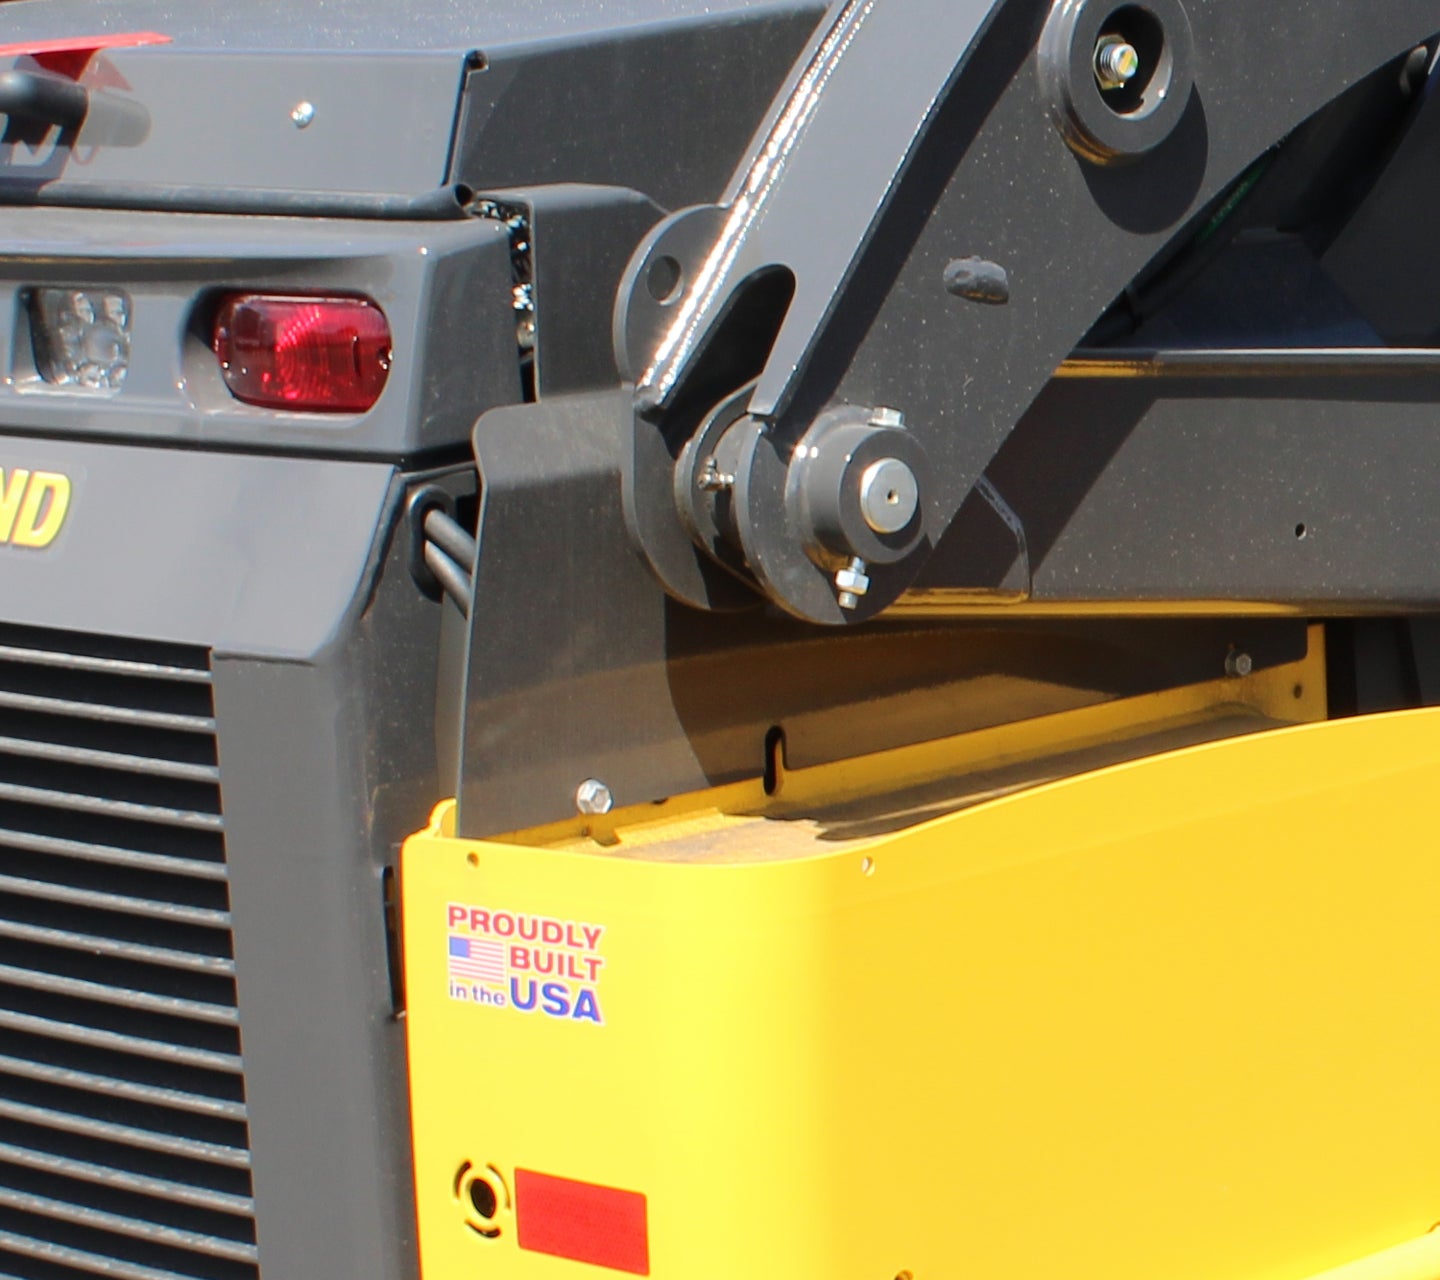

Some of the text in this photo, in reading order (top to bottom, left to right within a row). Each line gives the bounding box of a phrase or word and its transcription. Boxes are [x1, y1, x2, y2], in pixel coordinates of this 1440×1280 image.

[448, 904, 602, 951] PROUDLY
[510, 946, 602, 981] BUILT
[449, 977, 602, 1023] in the USA
